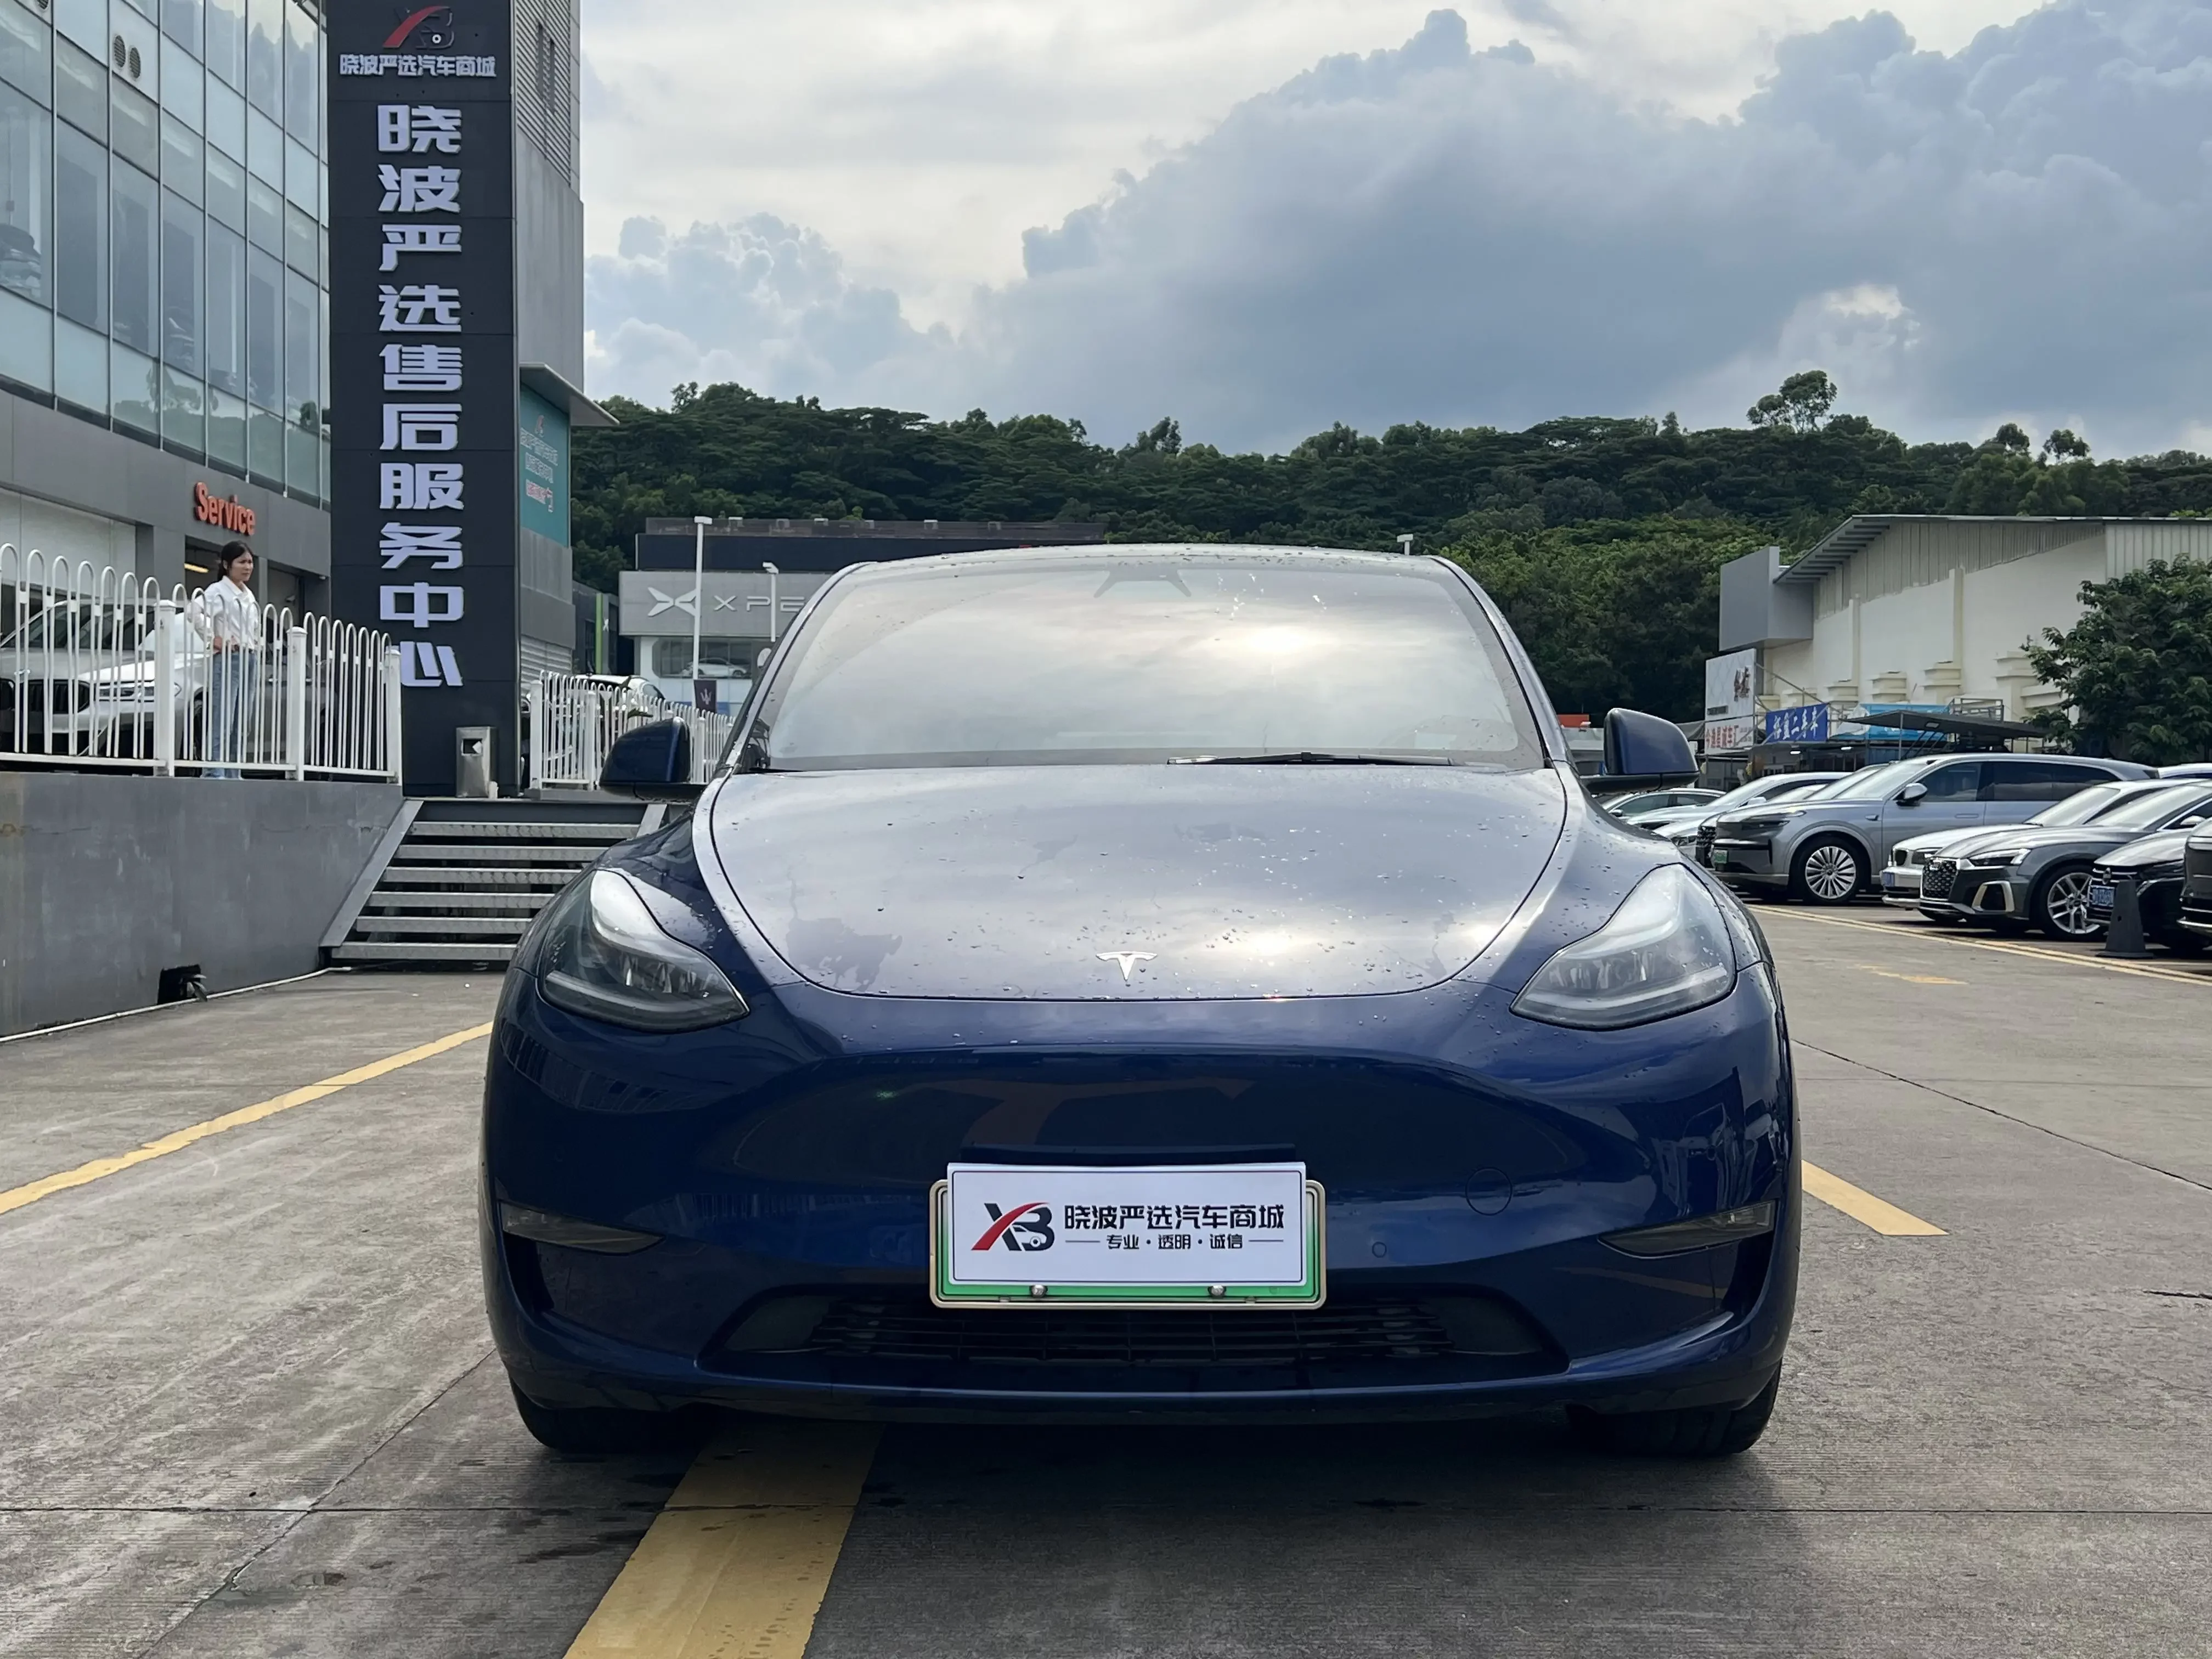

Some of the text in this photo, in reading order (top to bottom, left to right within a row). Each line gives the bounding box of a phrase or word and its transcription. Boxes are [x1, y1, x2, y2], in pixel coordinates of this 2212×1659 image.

[340, 54, 496, 77] 晓波严选汽车商城
[378, 105, 464, 687] 晓波严选售后服务中心
[194, 482, 255, 536] Service
[1064, 1205, 1284, 1229] 晓波严选汽车商城
